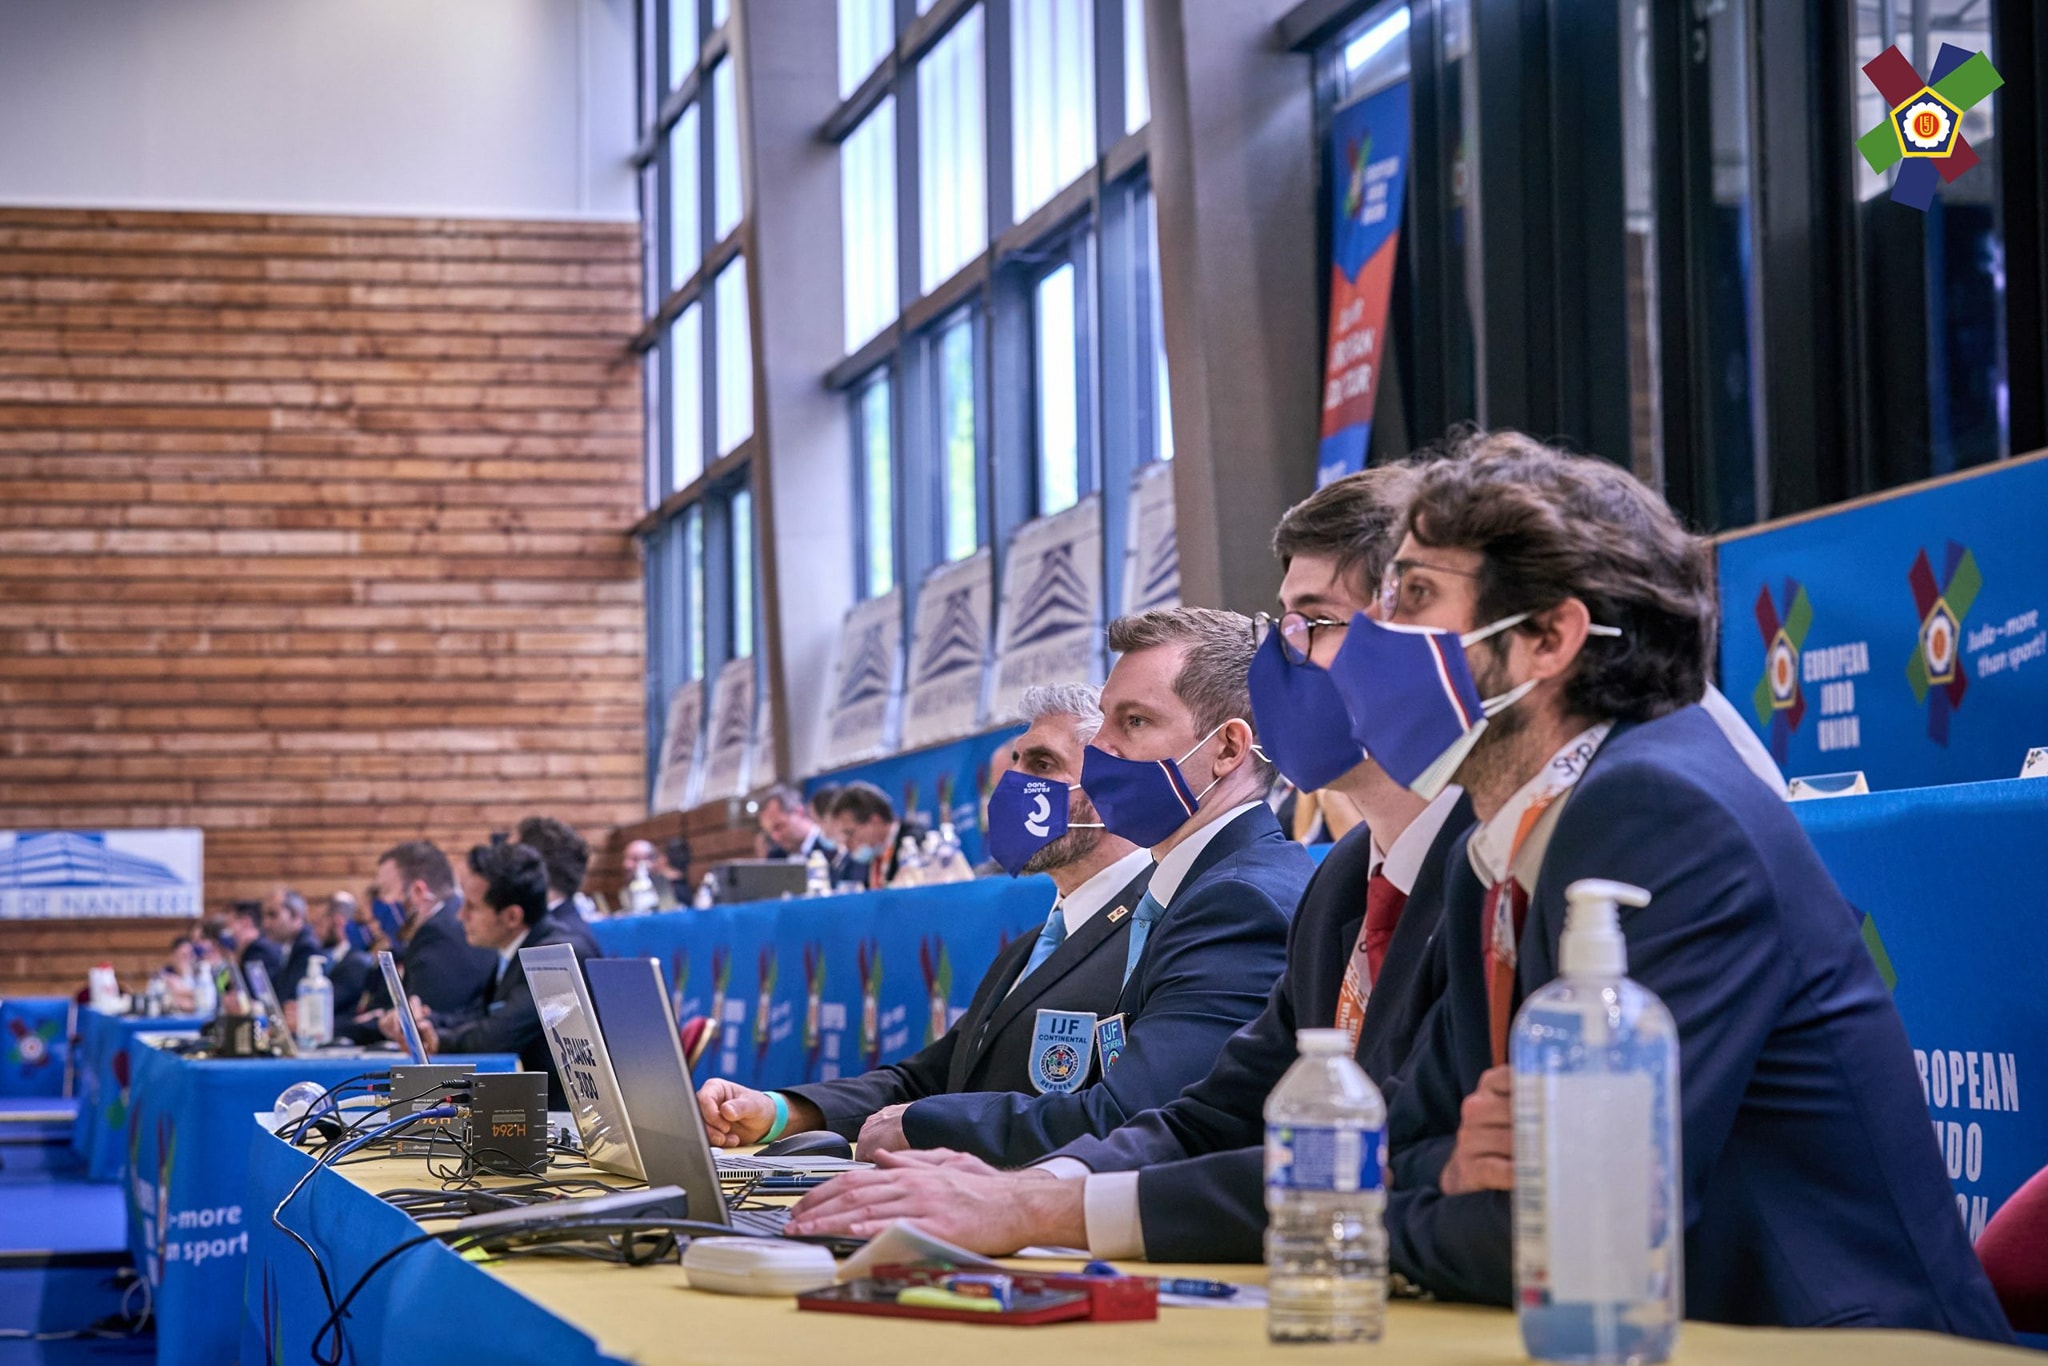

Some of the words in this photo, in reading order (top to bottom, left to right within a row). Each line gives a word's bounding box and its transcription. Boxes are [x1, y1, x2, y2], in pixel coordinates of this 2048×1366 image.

[1803, 640, 1870, 683] EUROPEAN
[1821, 679, 1855, 715] JUDO
[1818, 715, 1861, 752] UNION
[1039, 1033, 1088, 1044] CONTINENTAL
[1051, 1017, 1080, 1035] IJF
[1102, 1022, 1118, 1043] IJF
[562, 1037, 597, 1067] FRANCE
[575, 1071, 600, 1100] JUDO
[1040, 1079, 1072, 1091] REFEREE
[1912, 1048, 2020, 1113] ROPEAN
[491, 1123, 526, 1138] H.264
[1931, 1120, 1983, 1183] DO
